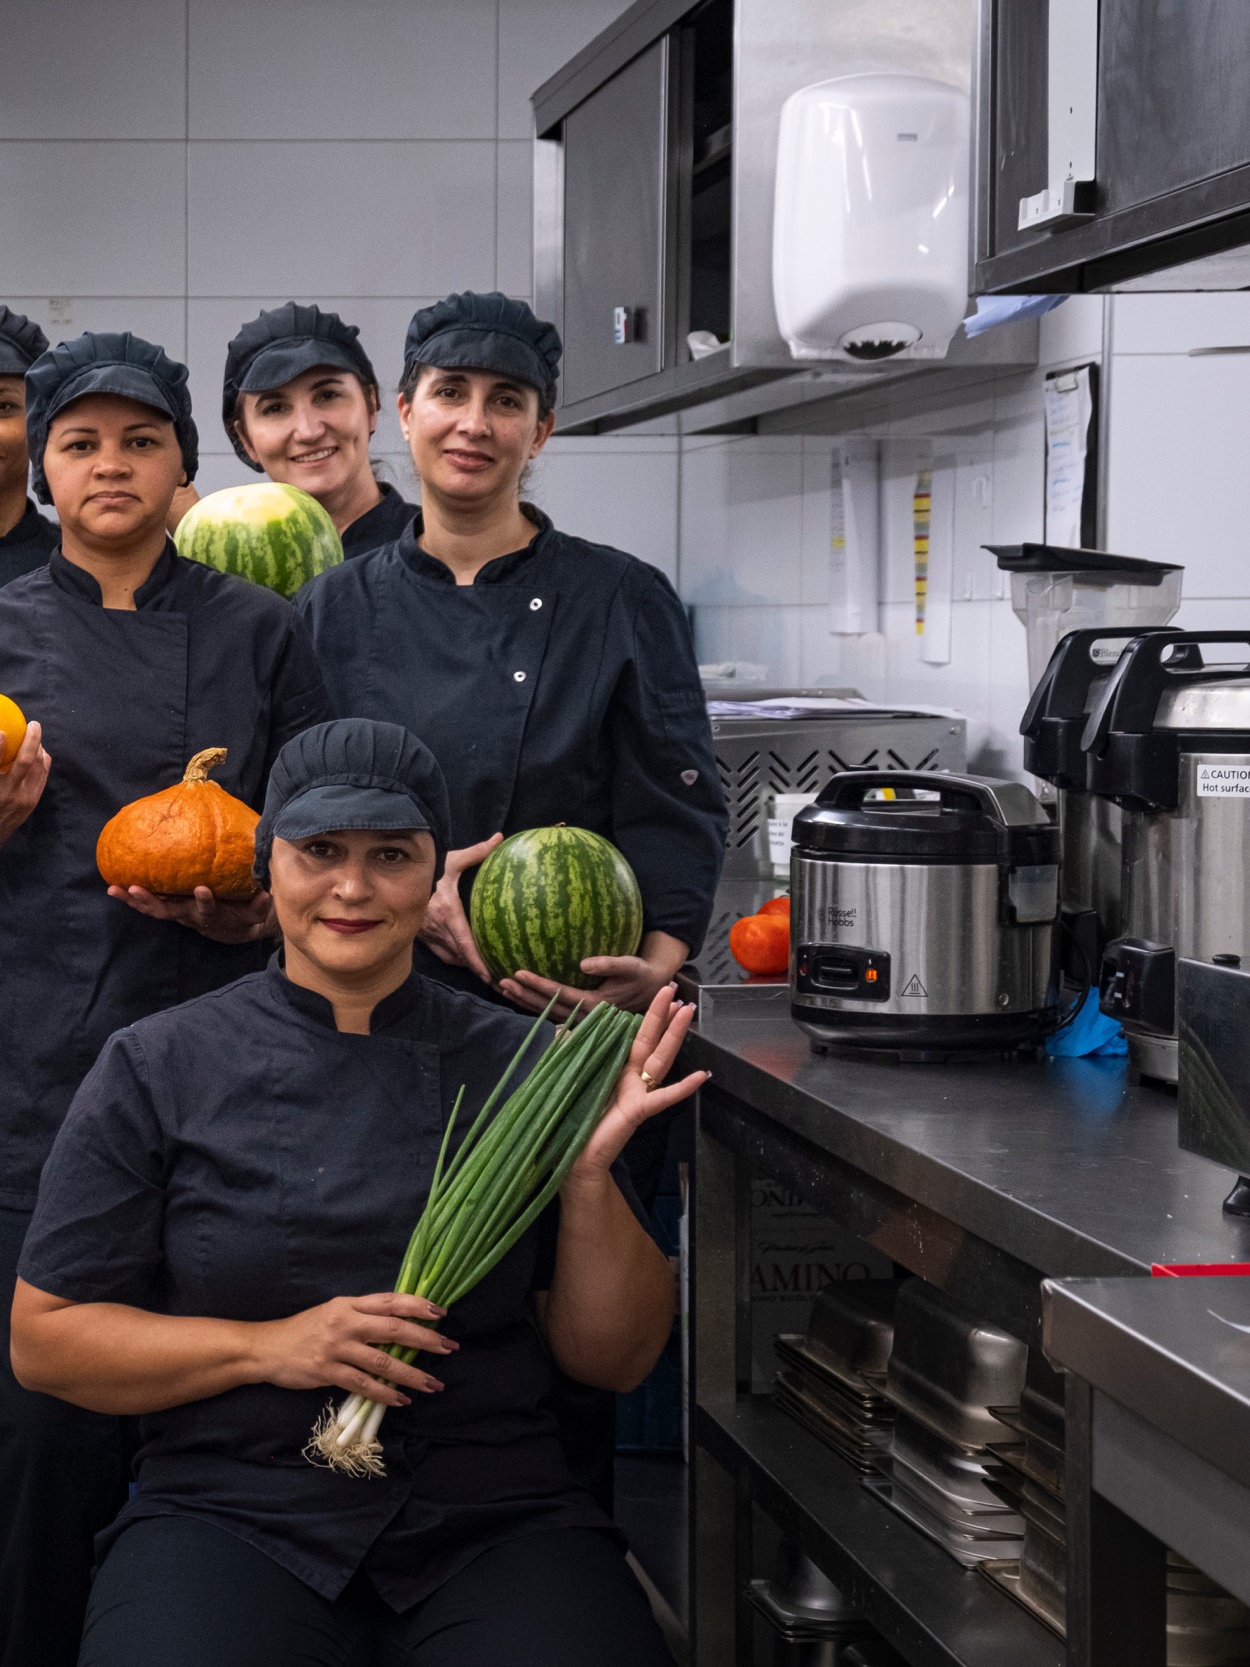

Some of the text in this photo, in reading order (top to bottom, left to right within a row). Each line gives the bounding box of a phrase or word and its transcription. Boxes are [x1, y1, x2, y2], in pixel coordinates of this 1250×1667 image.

[1203, 783, 1250, 793] Hot surfac
[828, 906, 857, 917] Russell
[828, 917, 854, 927] Hobbs
